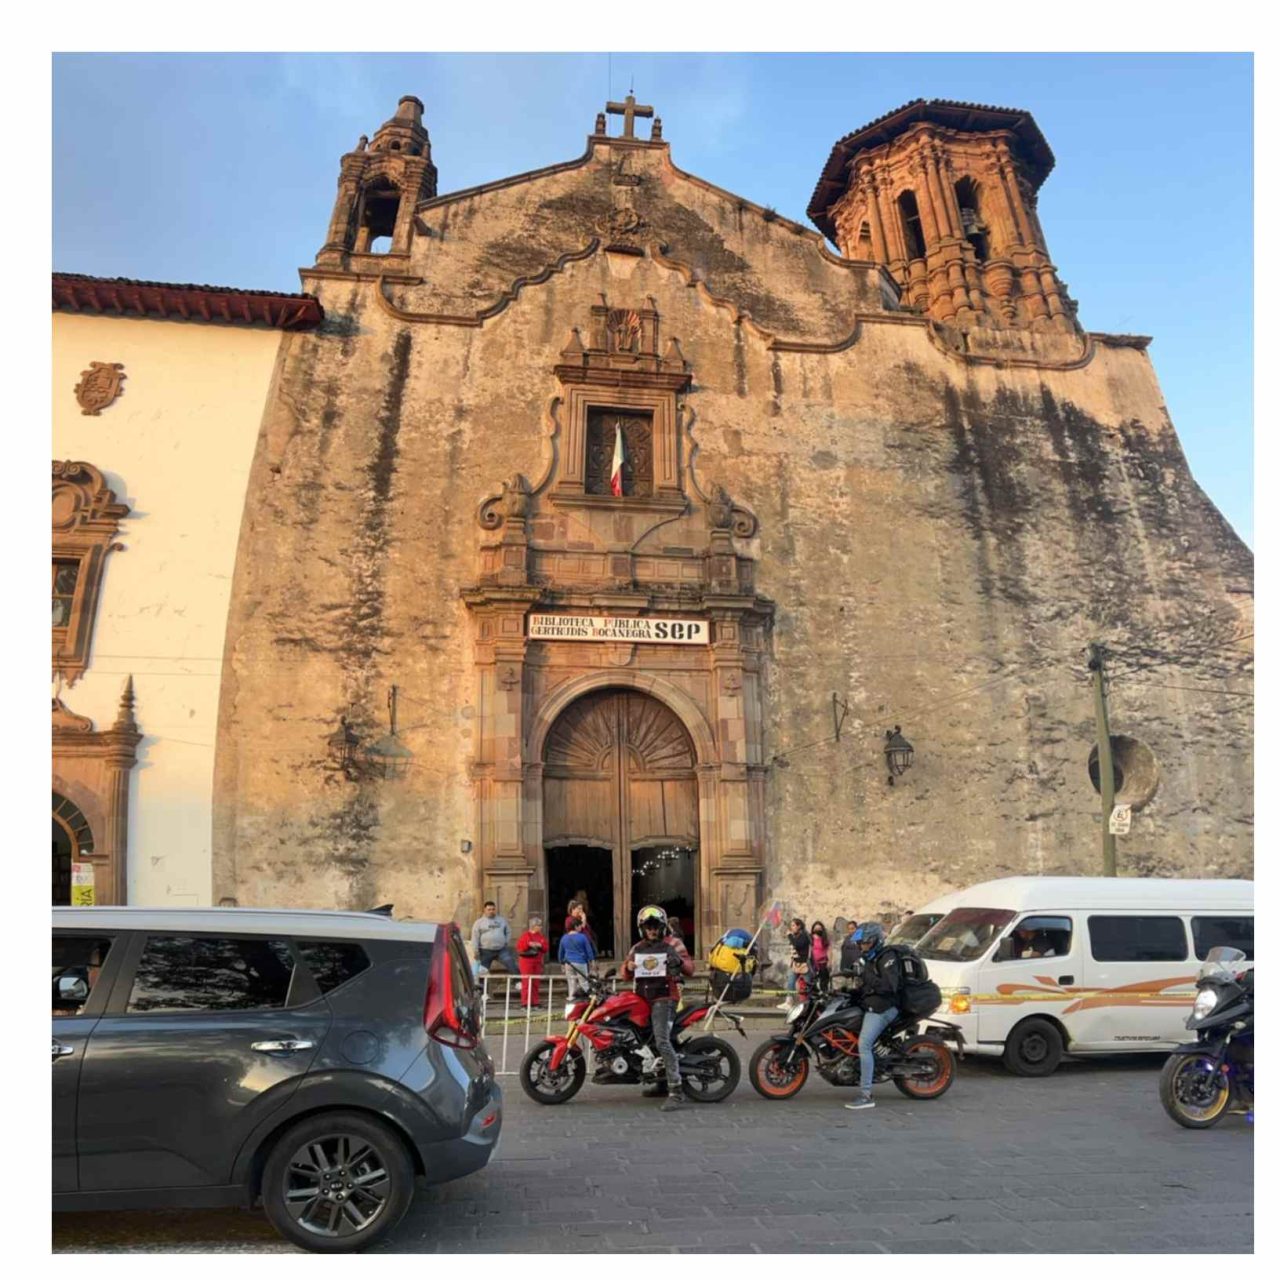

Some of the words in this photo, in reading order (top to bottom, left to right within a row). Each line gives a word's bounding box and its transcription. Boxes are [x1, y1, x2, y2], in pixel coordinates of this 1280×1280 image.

[533, 616, 594, 628] BIBLIOTECA
[531, 626, 588, 636] GERTRUDIS
[592, 628, 652, 639] BOCANEGRA
